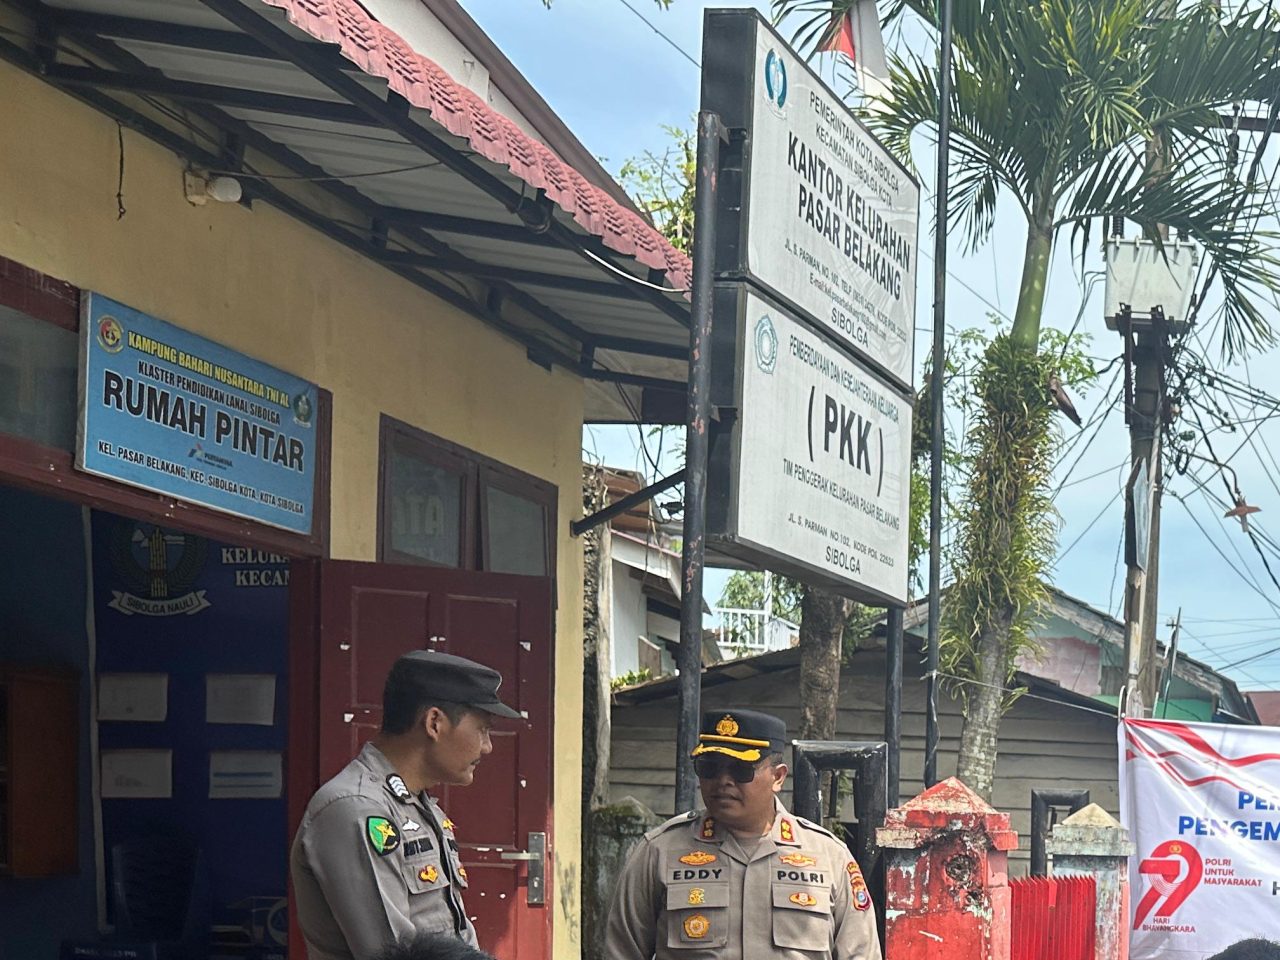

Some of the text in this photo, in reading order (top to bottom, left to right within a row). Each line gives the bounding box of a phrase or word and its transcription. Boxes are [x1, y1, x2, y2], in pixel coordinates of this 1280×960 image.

[810, 91, 899, 195] PEMERINTAH KOTA SIBOLGA
[815, 123, 892, 208] KECAMATAN SIBOLGA KOTA
[788, 131, 911, 273] KANTOR KELURAHAN
[798, 183, 902, 301] PASAR BELAKANG
[831, 307, 869, 348] SIBOLGA
[128, 331, 290, 408] KAMPUNG BAHARI NUSANTARA TNI AL
[138, 361, 281, 425] KLASTER PENDIDIKAN LANAL SIBOLGA
[102, 369, 305, 472] RUMAH PINTAR
[98, 441, 116, 457] KEL.
[117, 447, 145, 465] PASAR
[208, 476, 238, 494] SIBOLGA
[259, 492, 276, 506] KOTA
[277, 498, 304, 515] SIBOLGA
[783, 458, 900, 531] TIM PENGGERAK KELURAHAN PASAR BELAKANG
[804, 518, 828, 537] PARMAN
[825, 545, 861, 575] SIBOLGA
[126, 597, 194, 614] SIBOLGA NAULI
[673, 869, 723, 881] EDDY
[777, 870, 825, 884] POLRI
[1204, 877, 1262, 887] MASYARAKAT
[1205, 858, 1231, 866] POLRI
[1205, 868, 1234, 876] UNTUK
[1142, 925, 1196, 933] BHAYANGKARA
